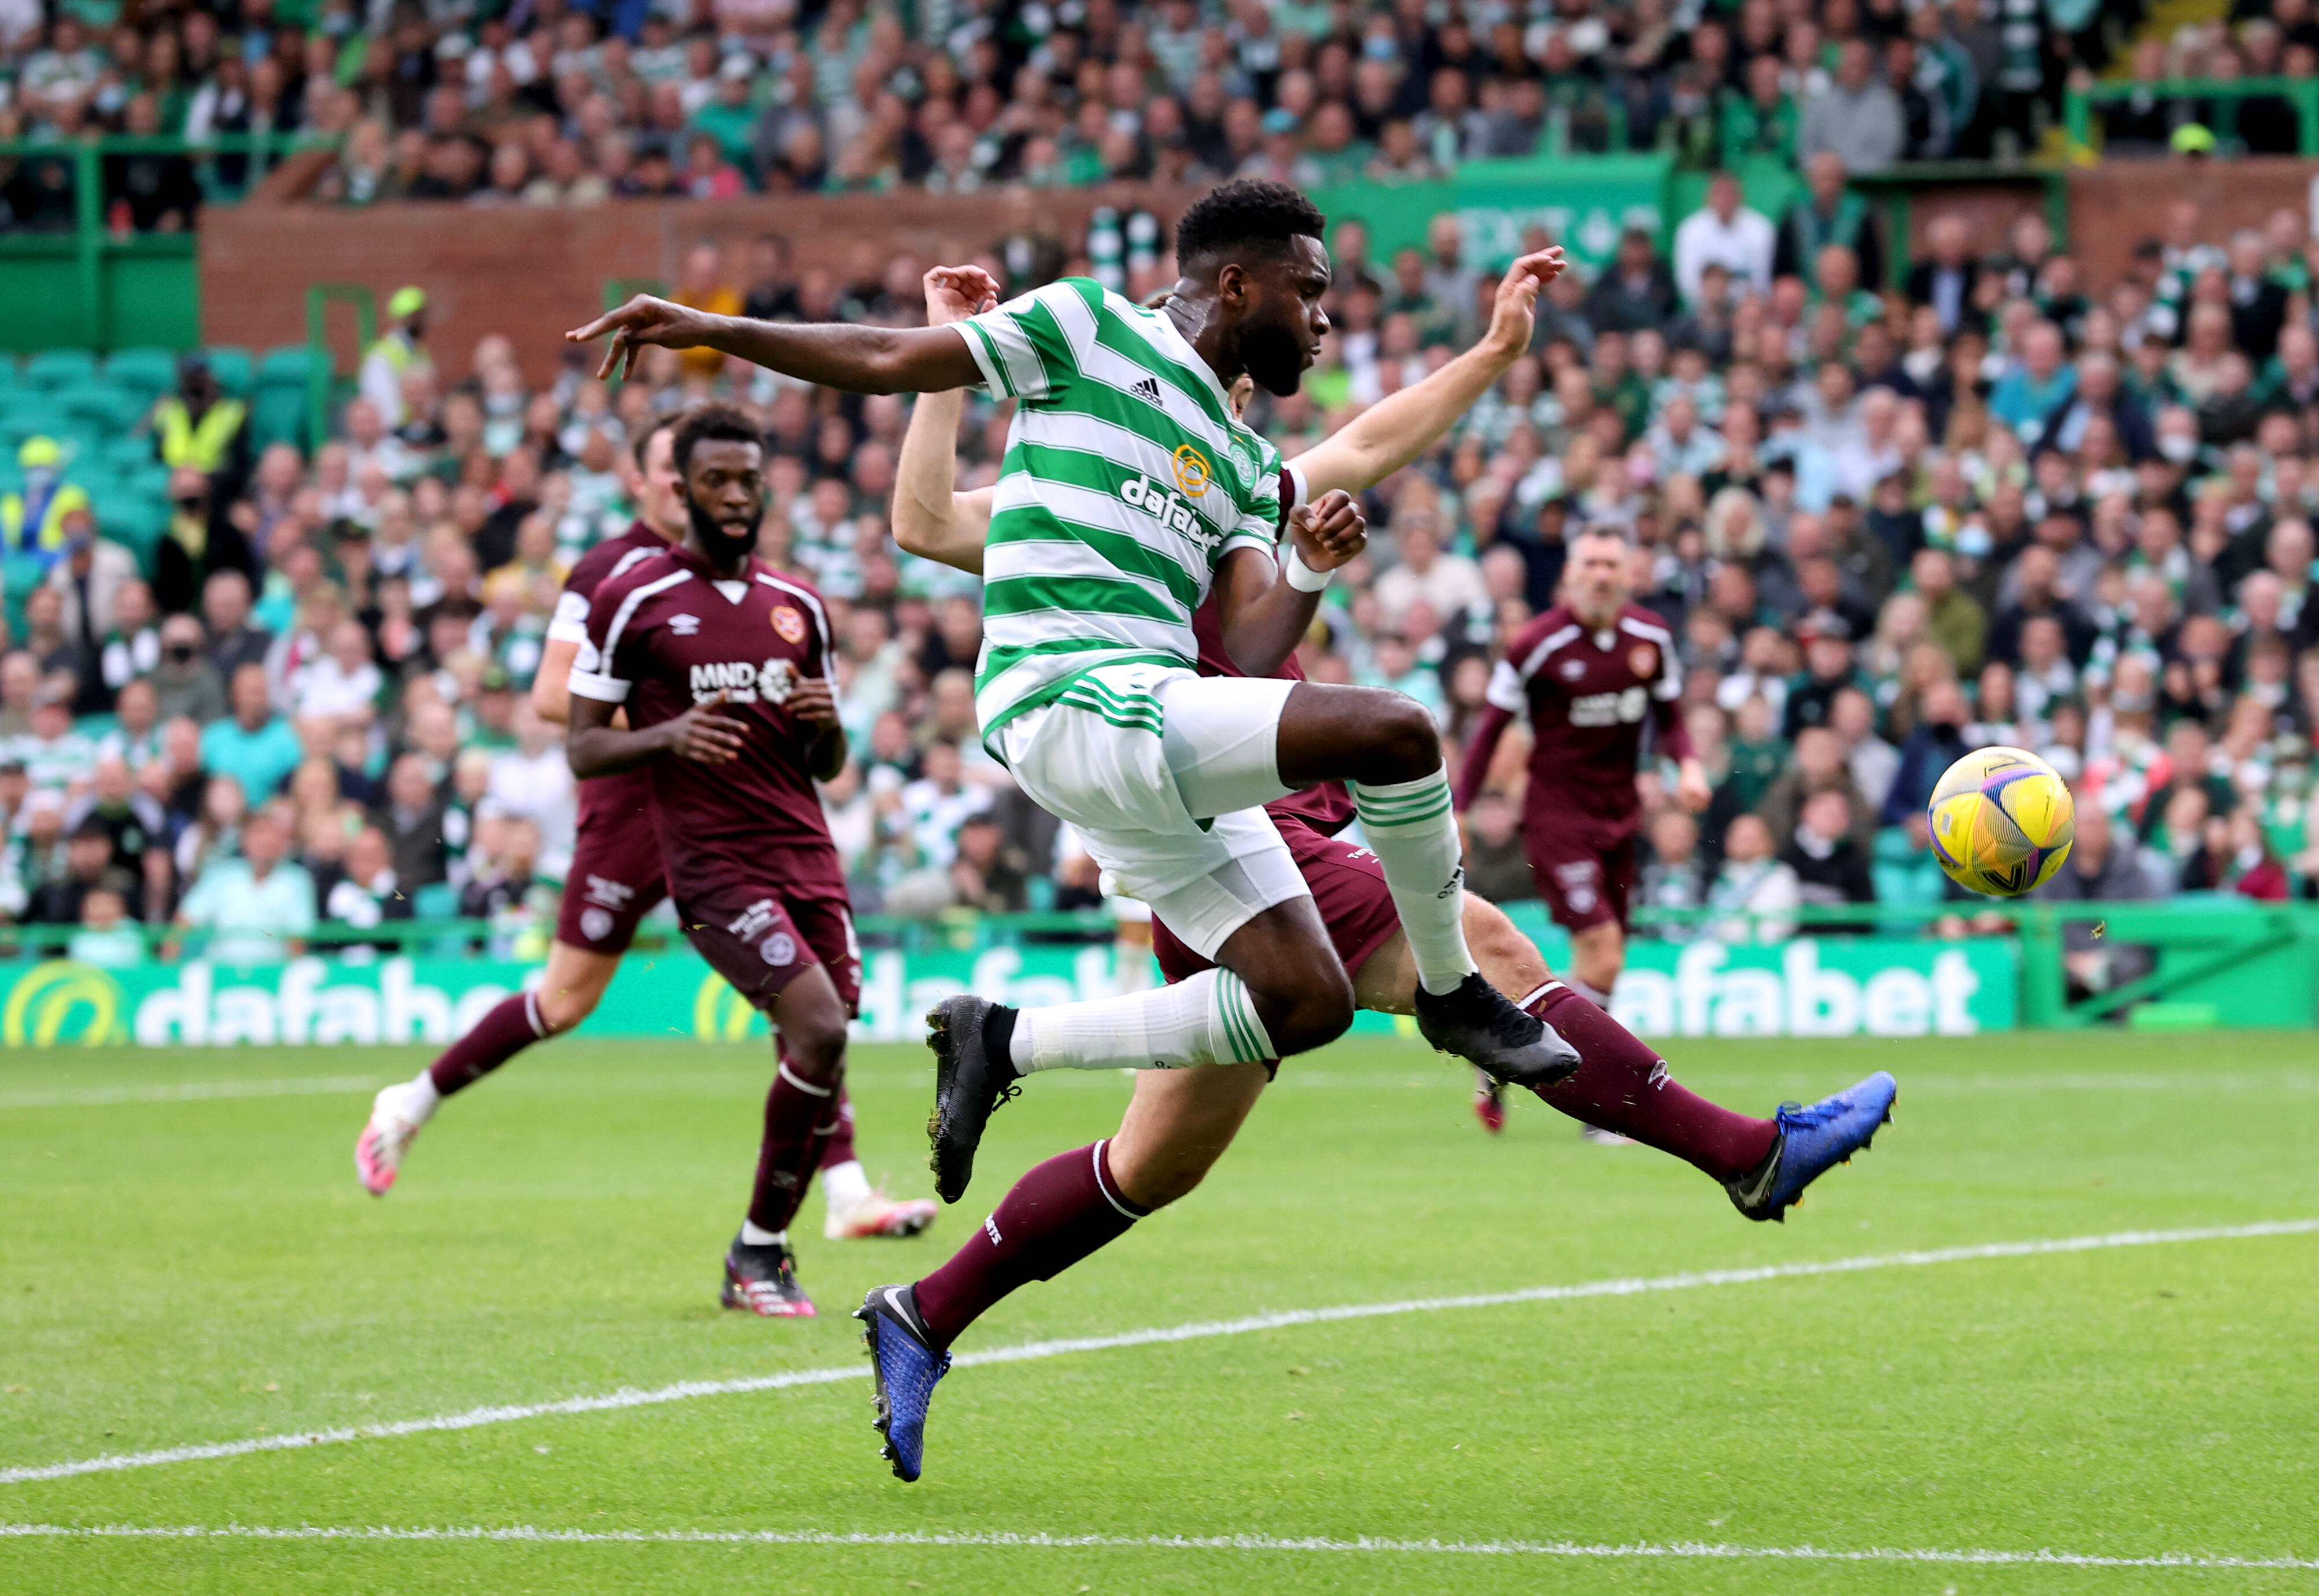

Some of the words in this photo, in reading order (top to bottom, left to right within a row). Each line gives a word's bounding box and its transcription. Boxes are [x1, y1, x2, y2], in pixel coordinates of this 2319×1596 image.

[1130, 385, 1163, 407] adidas
[690, 662, 757, 690] MND
[1608, 938, 1979, 1038] afabet
